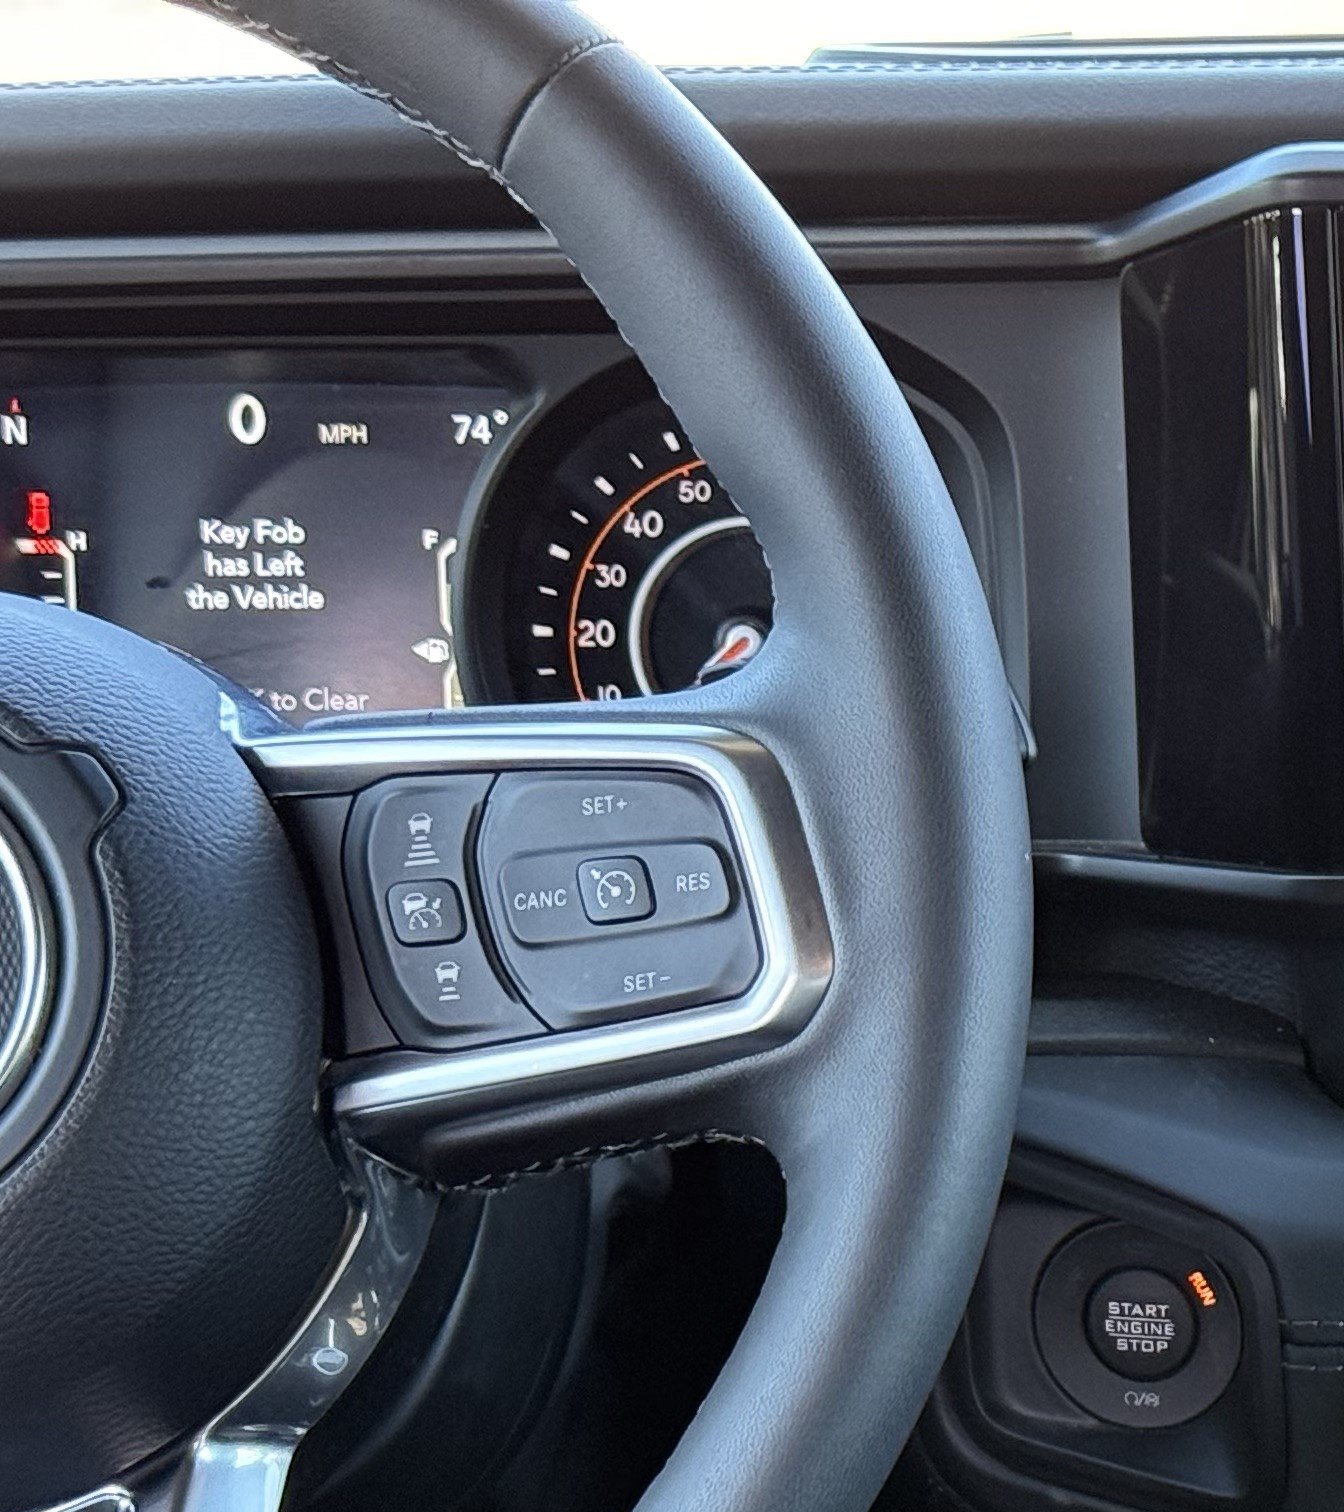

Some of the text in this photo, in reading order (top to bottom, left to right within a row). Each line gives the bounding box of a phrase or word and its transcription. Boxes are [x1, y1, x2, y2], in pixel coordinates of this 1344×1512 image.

[0, 413, 29, 445] N
[228, 392, 267, 445] 0
[317, 422, 369, 445] MPH
[677, 479, 713, 504] 50
[200, 516, 306, 548] Key Fob
[622, 509, 665, 539] 40
[66, 529, 88, 551] H
[421, 527, 440, 551] F
[203, 549, 305, 577] has Left
[594, 563, 627, 588] 30
[184, 581, 325, 611] the Vehicle
[577, 618, 616, 648] 20
[269, 690, 297, 711] to
[303, 686, 370, 712] Clear
[675, 872, 711, 893] RES
[514, 888, 568, 911] CANC
[1187, 1271, 1217, 1308] RUN
[1107, 1301, 1170, 1318] START
[1105, 1318, 1175, 1336] ENGINE
[1116, 1338, 1169, 1353] STOP
